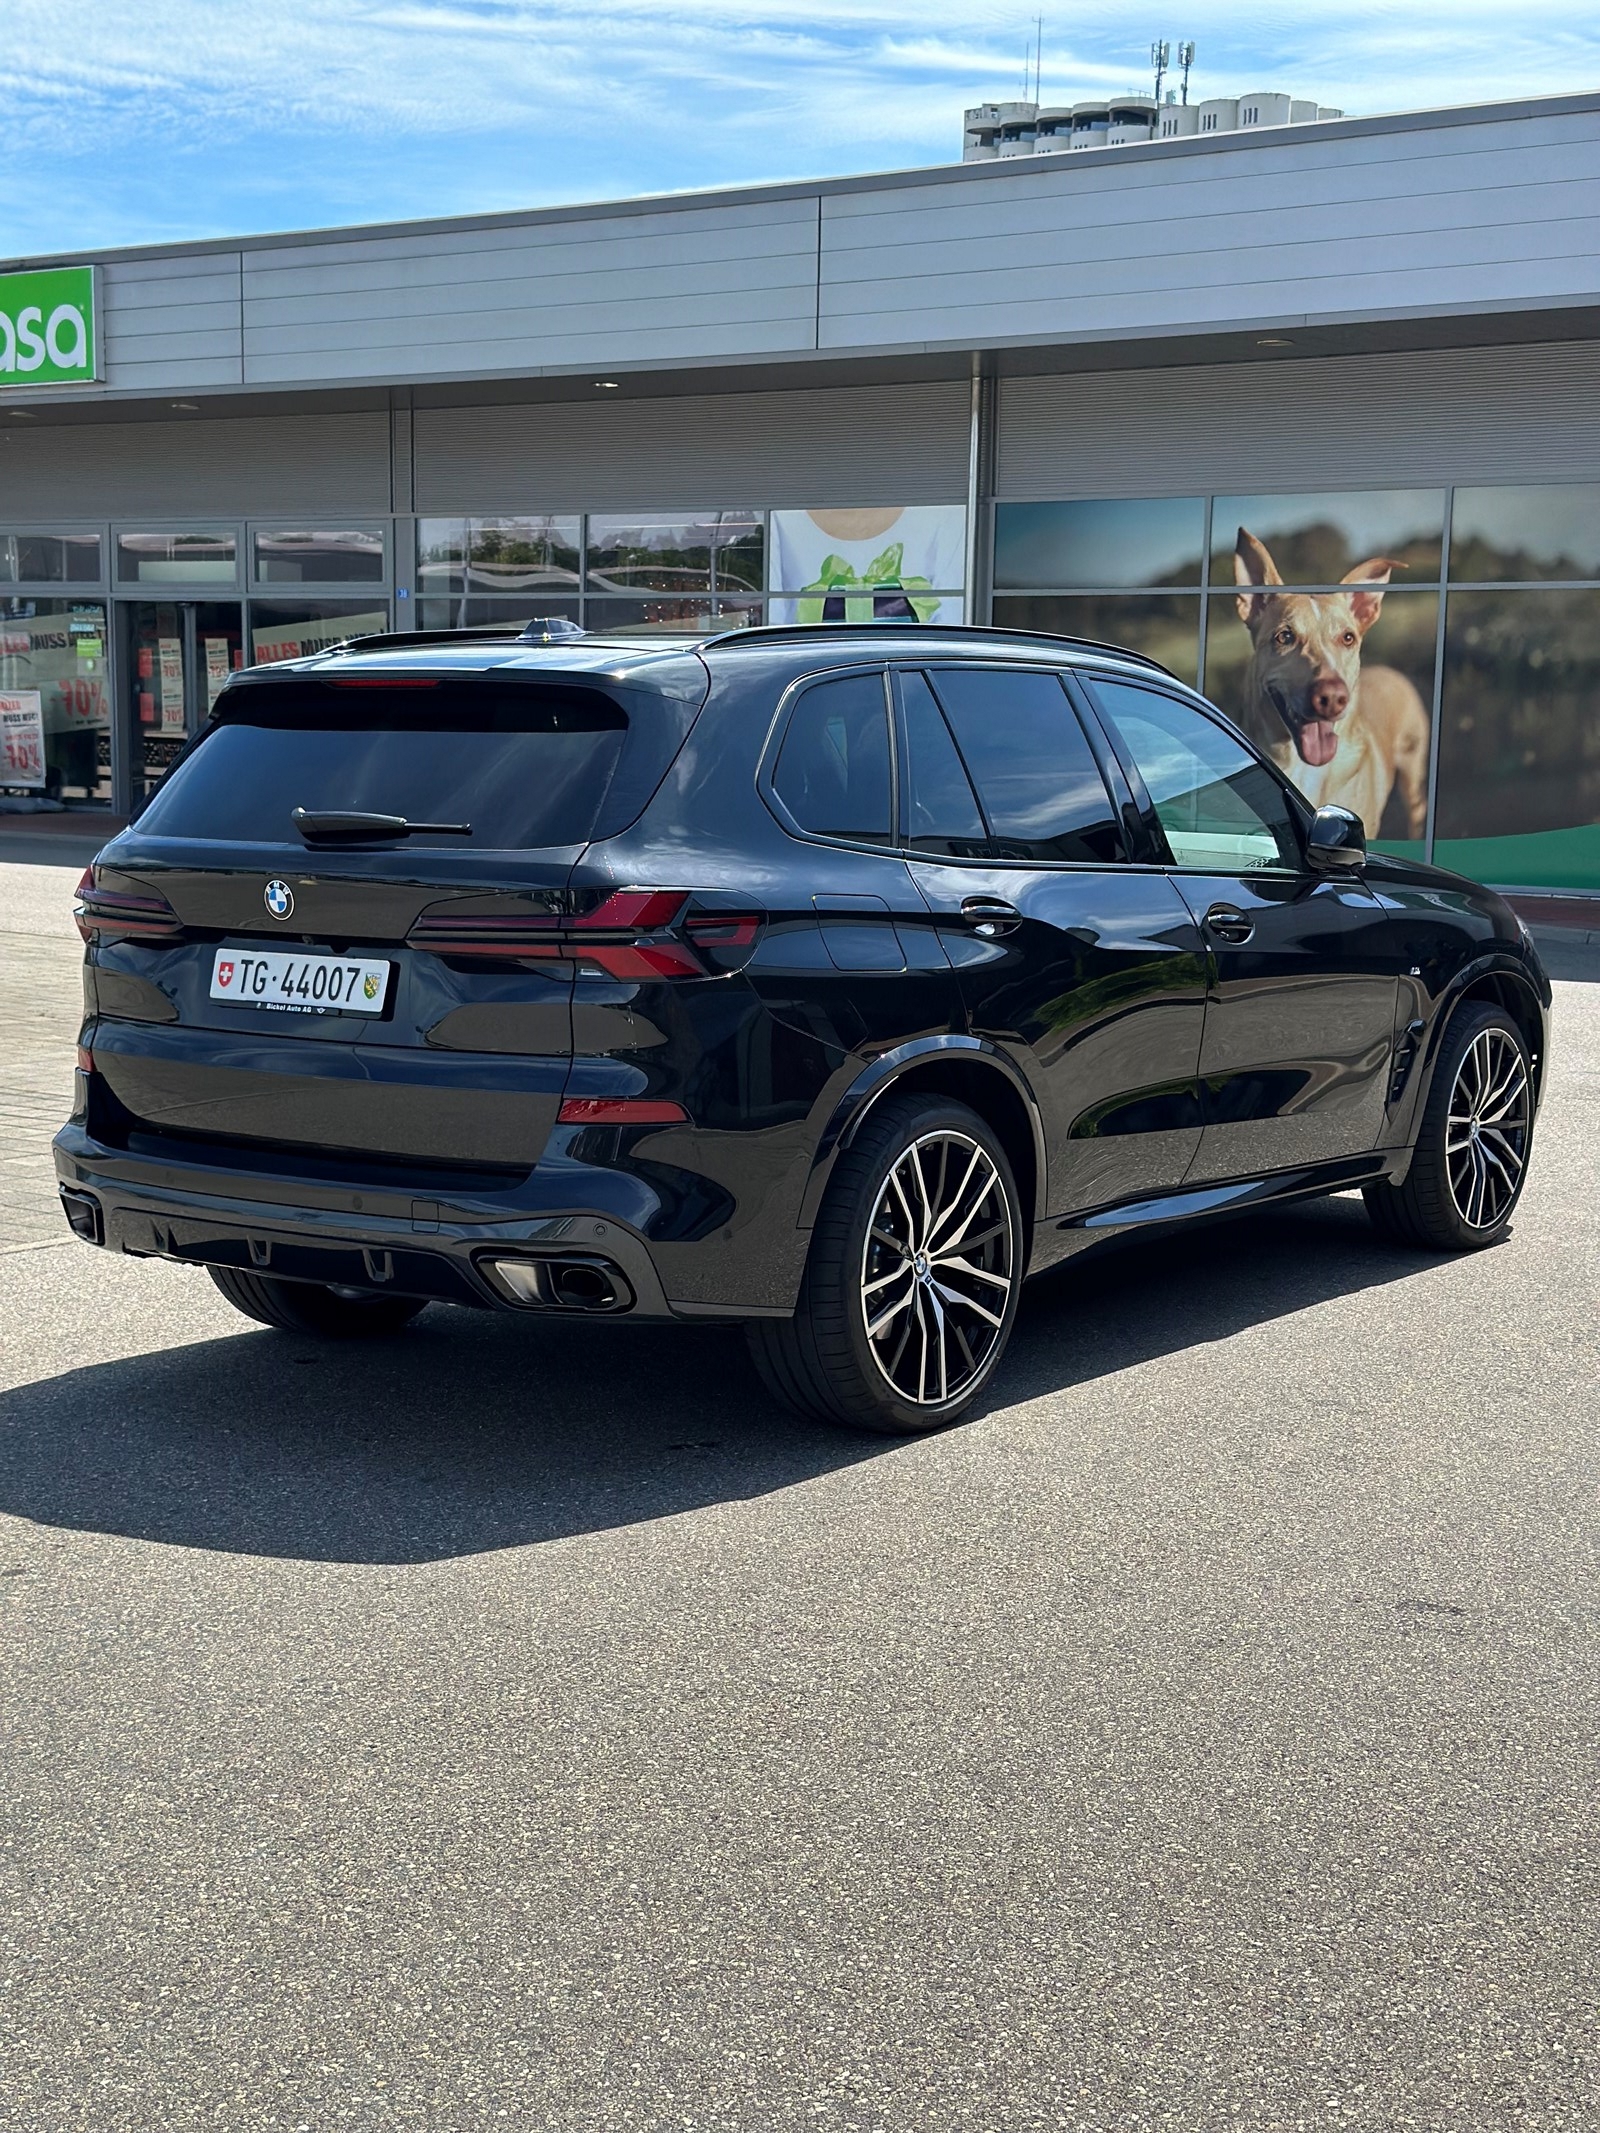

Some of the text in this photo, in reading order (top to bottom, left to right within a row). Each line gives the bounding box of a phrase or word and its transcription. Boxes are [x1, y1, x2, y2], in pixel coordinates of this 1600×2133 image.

[30, 632, 67, 651] MUSS
[256, 641, 299, 664] ALLES
[266, 1003, 286, 1011] Bickel
